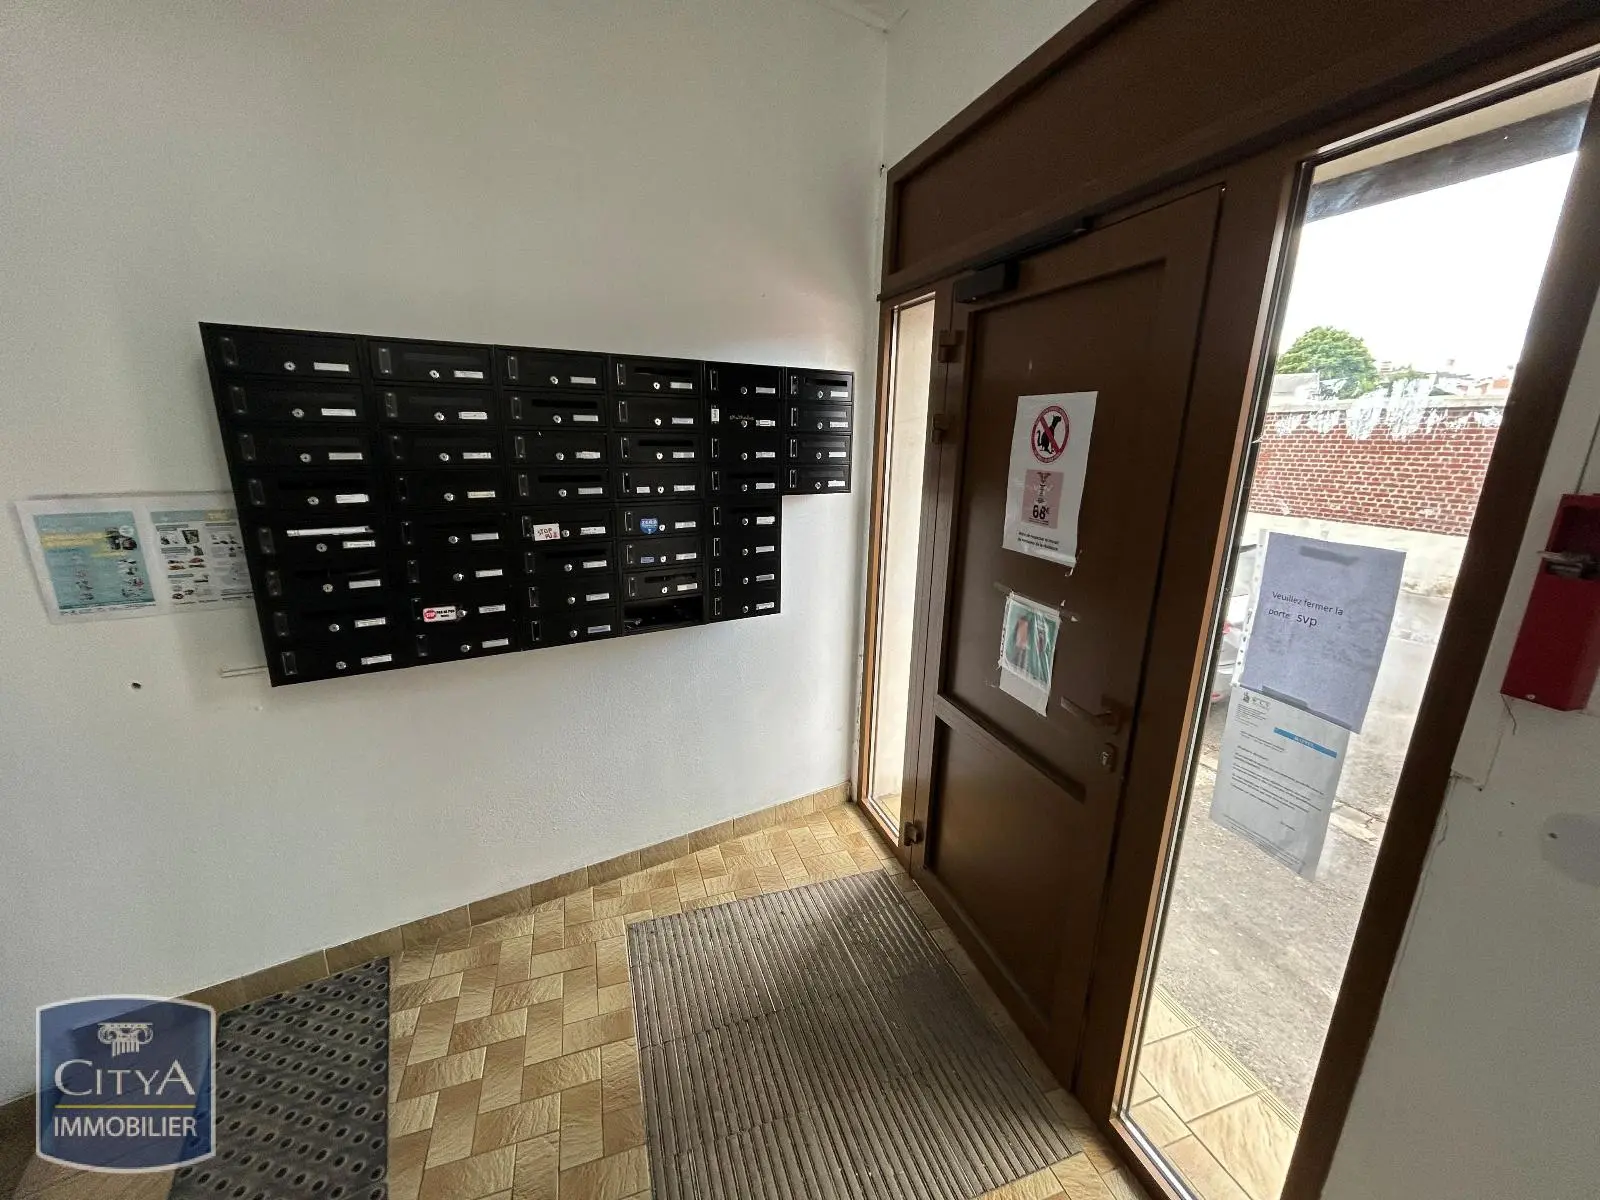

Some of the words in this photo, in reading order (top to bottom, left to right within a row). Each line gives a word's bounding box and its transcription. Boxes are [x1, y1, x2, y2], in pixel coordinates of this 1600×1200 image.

[1272, 591, 1302, 605] Veuillez
[1304, 599, 1334, 613] fermer
[1335, 606, 1344, 616] la
[1268, 608, 1291, 619] porte
[1296, 614, 1318, 628] svp
